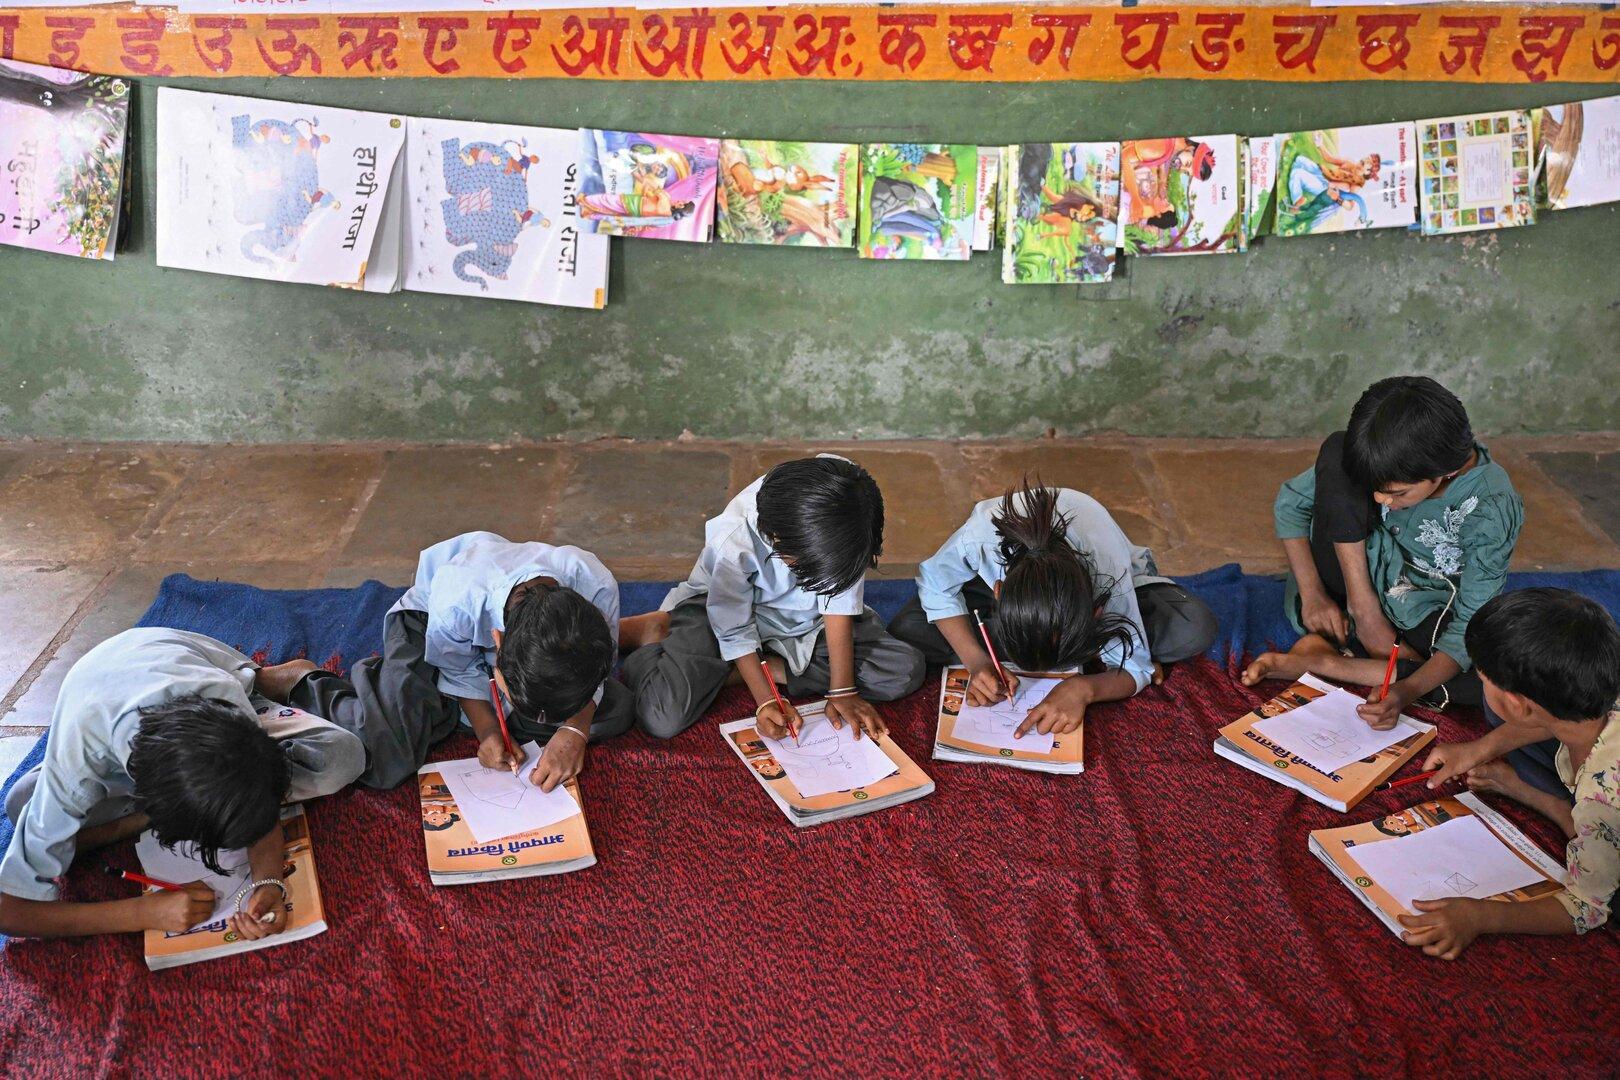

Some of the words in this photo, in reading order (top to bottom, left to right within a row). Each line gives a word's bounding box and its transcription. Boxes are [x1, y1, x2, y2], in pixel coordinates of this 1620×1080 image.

[45, 16, 95, 73] इ
[116, 9, 174, 76] ई
[192, 17, 248, 73] उ
[255, 17, 322, 75] ऊ
[336, 16, 400, 73] ऋ
[417, 17, 469, 74] ए
[487, 9, 541, 74] ऐ
[550, 7, 629, 76] ओ
[634, 7, 716, 79] औ
[720, 6, 785, 75] अं
[786, 13, 864, 77] अः
[877, 13, 937, 73] क
[948, 13, 1014, 73] ख
[1028, 13, 1092, 71] ग
[1114, 12, 1181, 74] घ
[1190, 11, 1245, 73] ङ
[1272, 14, 1338, 75] च
[1355, 13, 1422, 75] छ
[1439, 15, 1502, 76] ज
[1511, 14, 1586, 83] झ
[353, 146, 379, 198] हाथी
[342, 203, 368, 251] राजा
[447, 843, 505, 857] किताब
[508, 834, 565, 853] आपणी
